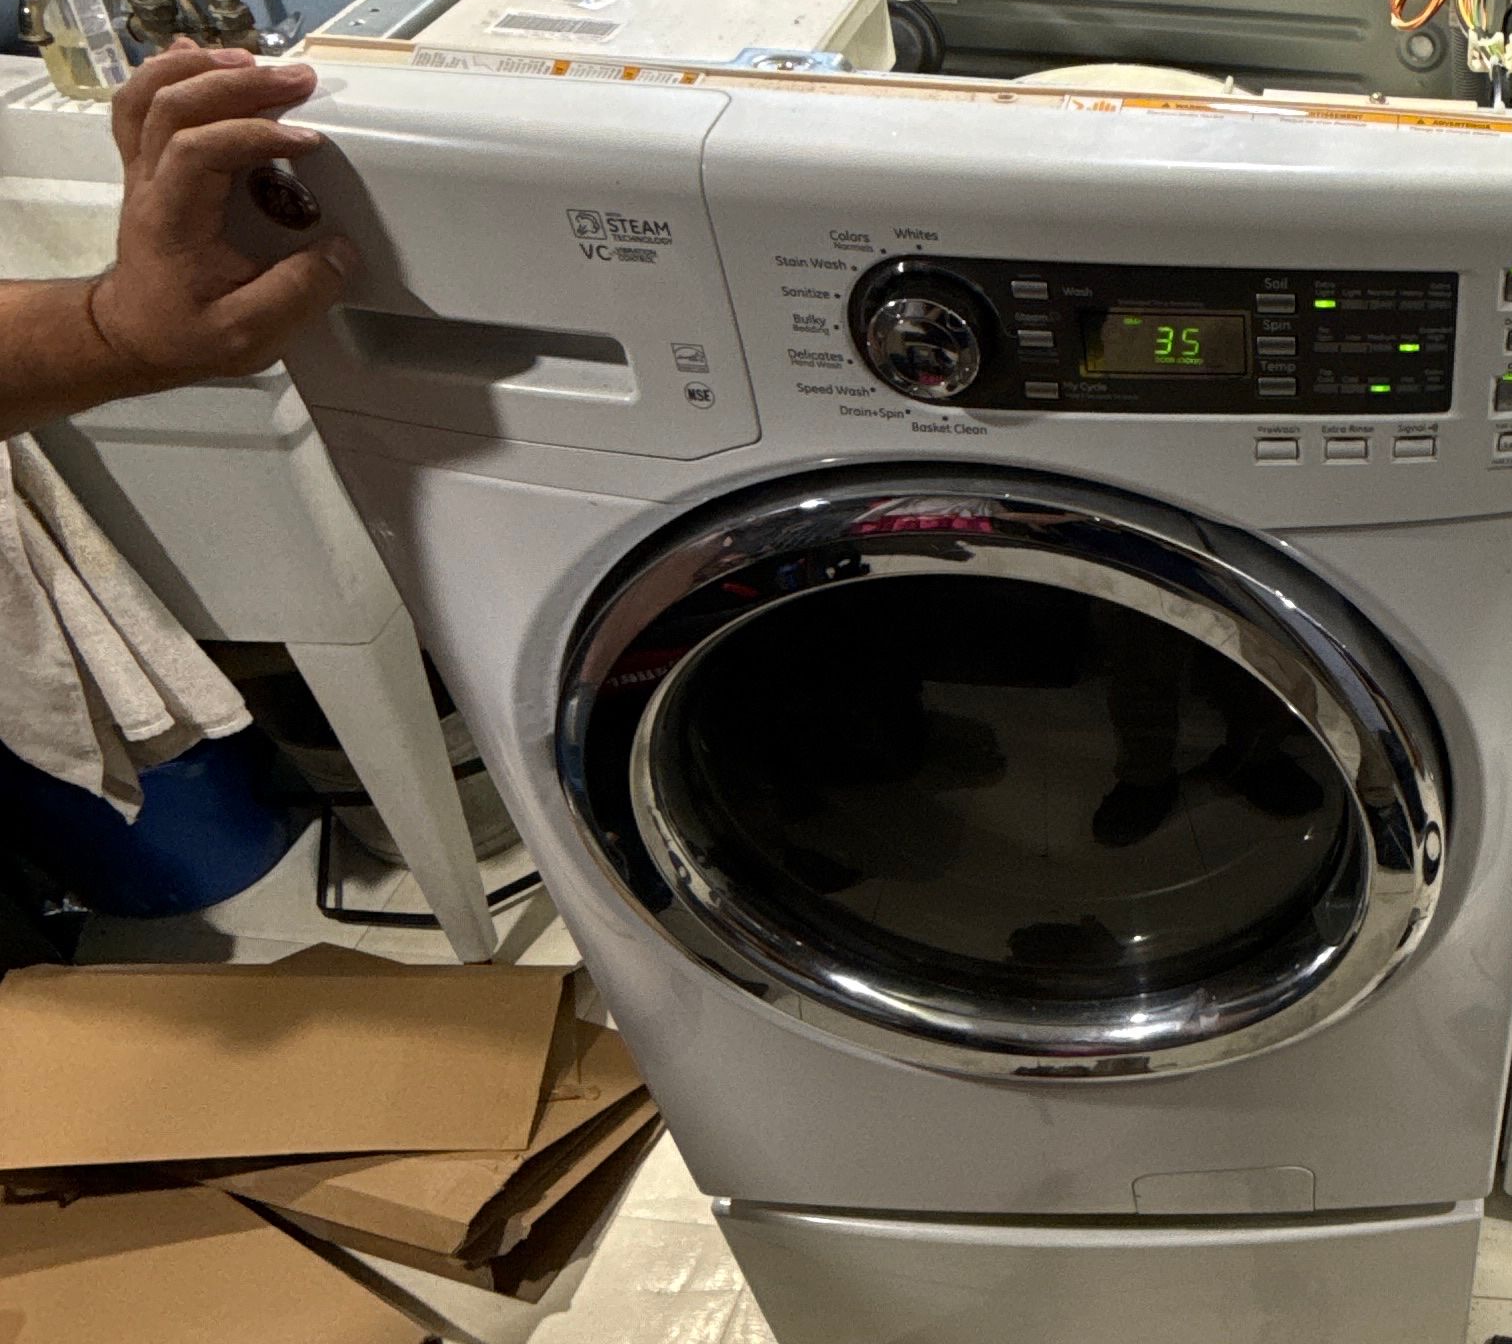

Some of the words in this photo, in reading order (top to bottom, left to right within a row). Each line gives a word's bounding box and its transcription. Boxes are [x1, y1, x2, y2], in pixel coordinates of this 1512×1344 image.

[605, 217, 672, 237] STEAM
[893, 227, 939, 241] Whites
[829, 229, 871, 243] Colors
[579, 242, 612, 261] VC
[774, 256, 809, 268] Stain
[810, 257, 847, 270] Wash
[1264, 276, 1289, 289] Soil
[781, 285, 831, 299] Sanitize
[1063, 287, 1093, 297] Wash
[793, 313, 827, 327] Bulky
[1263, 318, 1292, 332] Spin
[1154, 325, 1200, 356] 35
[787, 348, 845, 362] Delicates
[1261, 360, 1297, 374] Temp
[796, 382, 834, 396] Speed
[834, 384, 870, 397] Wash
[839, 405, 905, 420] Drain+Spin
[911, 421, 951, 434] Basket
[954, 423, 988, 435] Clean
